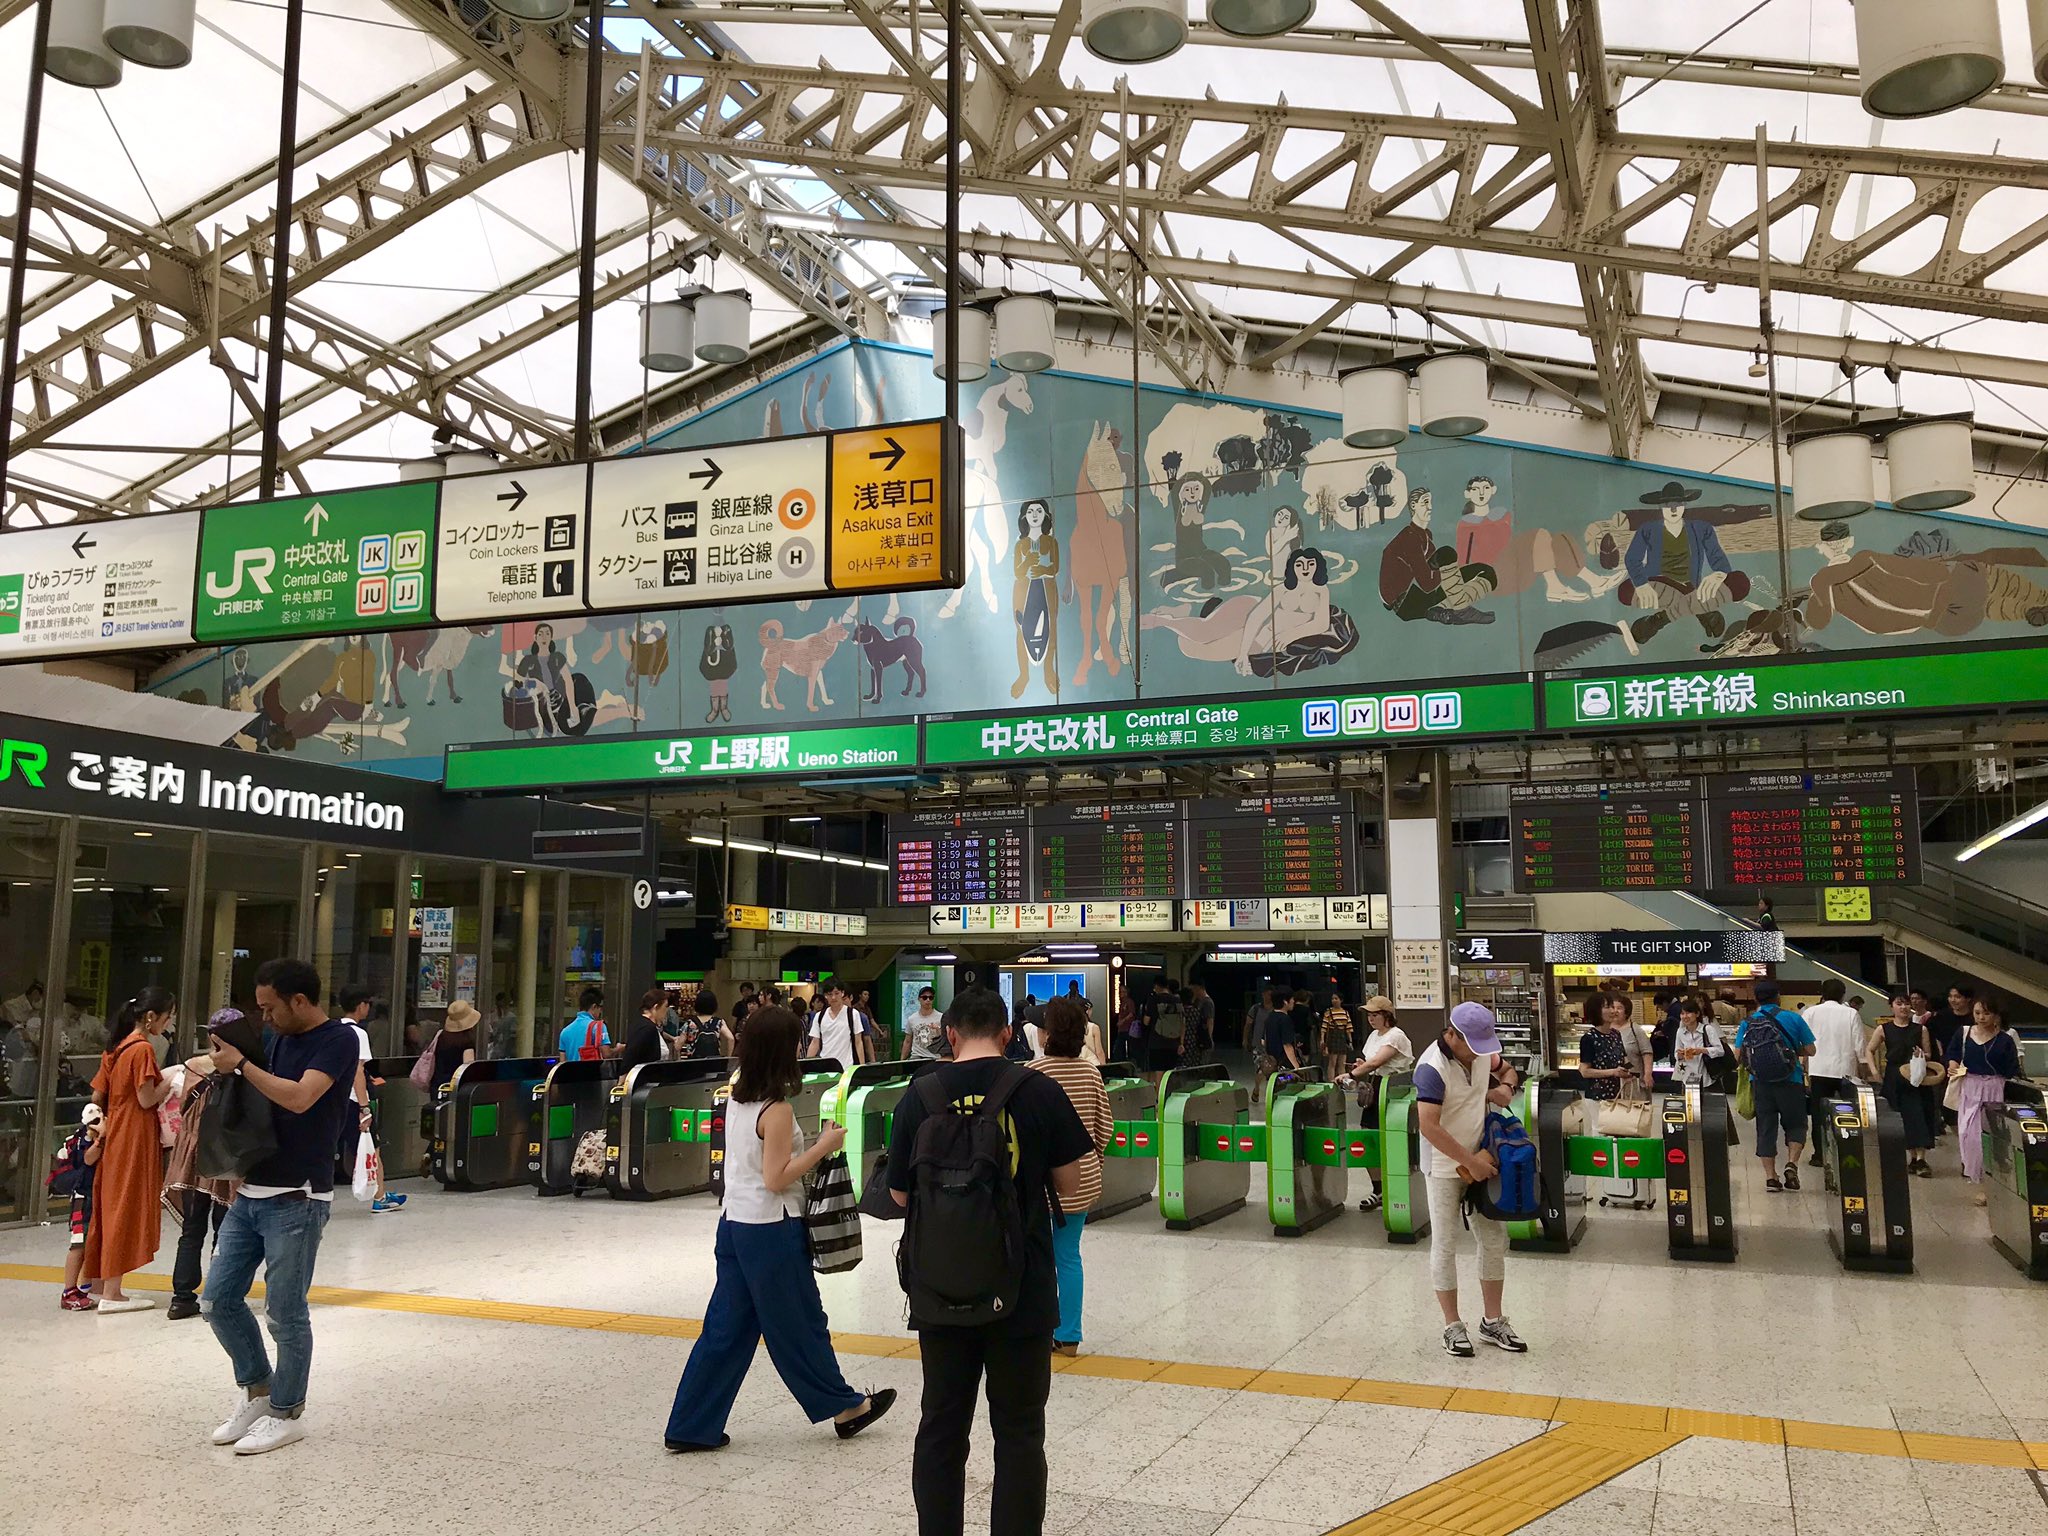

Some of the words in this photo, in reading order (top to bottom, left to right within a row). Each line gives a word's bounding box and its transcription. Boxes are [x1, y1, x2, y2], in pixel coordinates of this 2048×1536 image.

[853, 478, 933, 511] 浅草口
[711, 494, 773, 520] 銀座線
[790, 502, 803, 517] G
[621, 506, 658, 528] バス
[842, 516, 902, 533] Asakusa
[907, 511, 933, 528] Exit
[446, 520, 539, 546] コインロッカー
[636, 531, 658, 543] Bus
[710, 523, 744, 537] Ginza
[748, 521, 773, 533] Line
[880, 532, 933, 550] 浅草出口
[284, 539, 350, 569] 中央改札
[365, 546, 383, 563] JK
[400, 542, 418, 559] JY
[469, 548, 493, 560] Coin
[497, 544, 539, 557] Lockers
[666, 549, 694, 561] TAXI
[707, 542, 772, 568] 日比谷線
[790, 550, 802, 564] H
[598, 554, 657, 576] タクシー
[848, 554, 901, 573] 아사쿠사
[906, 552, 933, 568] 출구
[27, 565, 98, 590] びゅうプラザ
[206, 547, 276, 599] JR
[283, 573, 320, 589] Central
[322, 570, 348, 585] Gate
[501, 563, 538, 585] 電話
[707, 571, 743, 585] Hibiya
[747, 568, 772, 580] Line
[118, 580, 162, 592] 旅行カウンター
[635, 577, 657, 590] Taxi
[27, 592, 55, 604] Ticketing
[57, 591, 70, 601] and
[282, 589, 333, 605] 中央检票口
[363, 588, 381, 604] JU
[399, 584, 415, 600] JJ
[487, 589, 537, 604] Telephone
[26, 606, 45, 618] Travel
[48, 604, 71, 616] Service
[72, 602, 95, 613] Center
[213, 598, 264, 616] JR東日本
[281, 611, 301, 624] 중앙
[306, 607, 337, 621] 개찰구
[115, 625, 122, 633] JR
[122, 623, 135, 632] EAST
[136, 622, 150, 631] Travel
[150, 621, 167, 630] Service
[169, 620, 185, 629] Center
[1623, 672, 1757, 719] 新幹線
[1772, 686, 1906, 712] Shinkansen
[1125, 709, 1189, 729] Central
[1195, 707, 1239, 724] Gate
[1311, 711, 1330, 726] JK
[1350, 708, 1370, 724] JY
[1389, 706, 1411, 721] JU
[1433, 703, 1449, 719] JJ
[981, 714, 1116, 756] 中央改札
[1126, 730, 1197, 748] 中央检票口
[1209, 727, 1239, 743] 중앙
[1245, 724, 1291, 741] 개찰구
[655, 741, 694, 766] JR
[700, 735, 790, 771] 上野駅
[798, 752, 838, 767] Ueno
[842, 748, 898, 764] Station
[66, 750, 187, 805] ご案内
[198, 769, 405, 833] Information
[912, 812, 954, 823] 上野東京ライン
[1628, 815, 1648, 824] MITO
[1830, 807, 1859, 816] いわき
[1624, 828, 1653, 836] TORIDE
[1832, 833, 1861, 842] いわき
[937, 840, 960, 849] 13:50
[1166, 843, 1174, 851] 15
[1683, 838, 1690, 847] 6
[937, 851, 960, 859] 13:59
[965, 850, 979, 858] 品川
[1630, 852, 1649, 860] MITO
[1682, 851, 1691, 859] 10
[1834, 858, 1862, 867] いわき
[937, 861, 960, 869] 14:01
[1626, 865, 1654, 873] TORIDE
[1683, 864, 1692, 872] 12
[965, 870, 979, 878] 品川
[1684, 876, 1692, 884] 6
[938, 882, 960, 890] 14:11
[1167, 887, 1175, 895] 13
[938, 892, 961, 901] 14:20
[425, 909, 447, 922] 京浜
[1086, 905, 1092, 913] 8
[1611, 941, 1637, 953] THE
[1641, 941, 1670, 953] GIFT
[1674, 940, 1712, 953] SHOP
